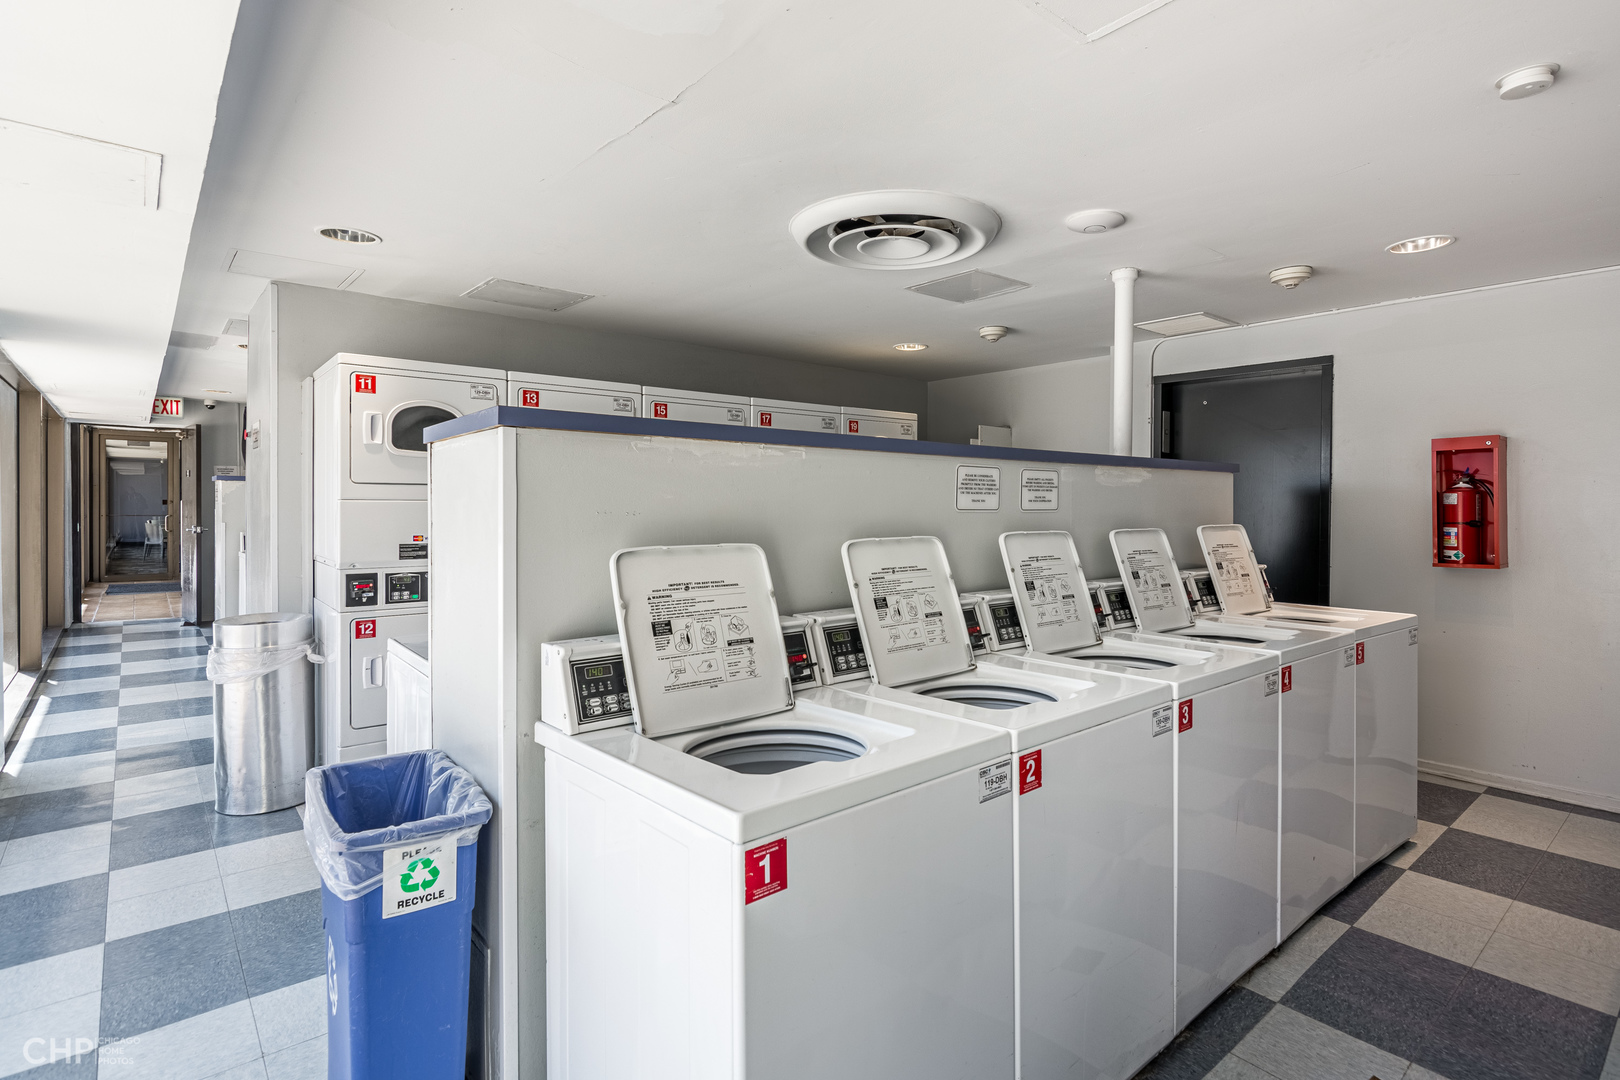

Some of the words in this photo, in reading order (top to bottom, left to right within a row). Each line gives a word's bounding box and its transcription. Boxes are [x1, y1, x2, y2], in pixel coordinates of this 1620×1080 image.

[358, 378, 372, 390] 11
[525, 393, 537, 403] 13
[152, 398, 180, 415] EXIT
[656, 406, 666, 415] 15
[762, 415, 770, 423] 17
[359, 623, 373, 634] 12
[1358, 646, 1362, 659] 5
[589, 668, 603, 676] 140
[1284, 671, 1289, 685] 4
[1182, 706, 1188, 724] 3
[1026, 760, 1035, 783] 2
[984, 773, 1007, 788] 119-DBH
[759, 854, 770, 884] 1
[397, 890, 445, 909] RECYCLE
